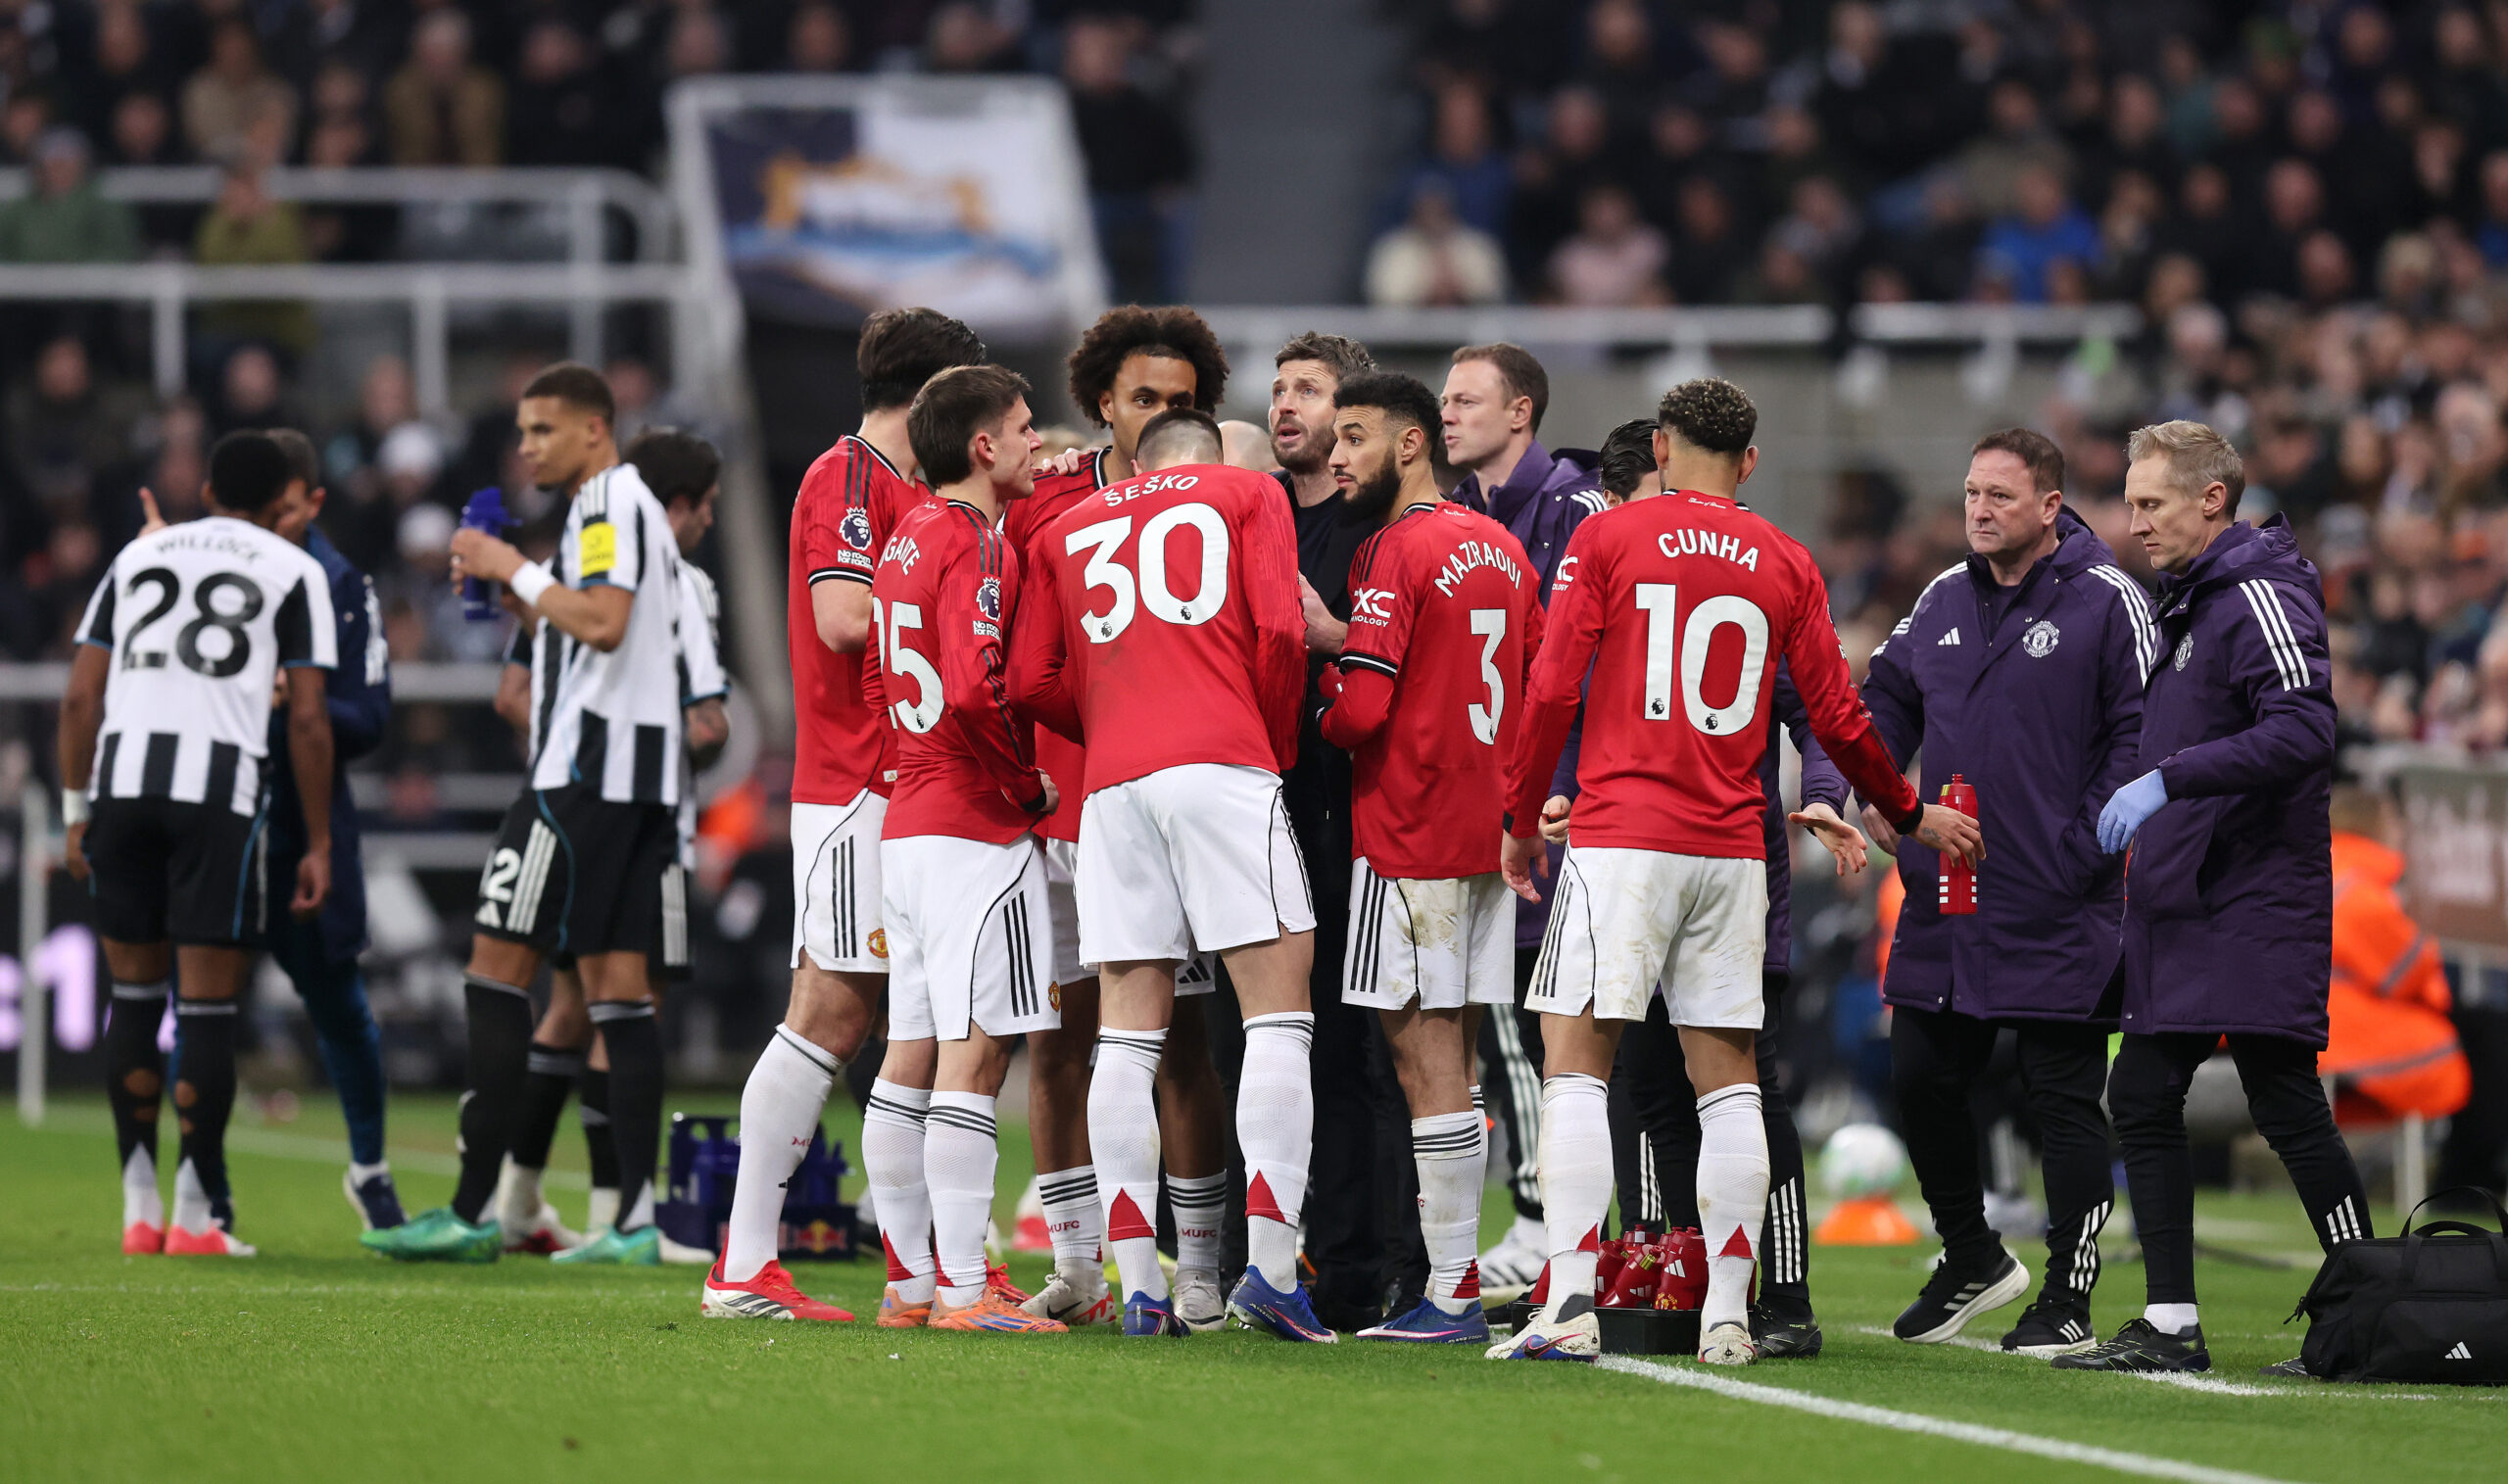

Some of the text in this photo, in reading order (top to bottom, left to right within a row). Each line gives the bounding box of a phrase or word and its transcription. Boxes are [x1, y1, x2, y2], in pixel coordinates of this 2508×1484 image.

[1103, 474, 1199, 507] ŠEŠKO
[157, 534, 262, 565] WILLOCK
[838, 550, 851, 558] No
[1658, 528, 1760, 573] CUNHA
[1065, 502, 1230, 644] 30
[1433, 540, 1521, 598] MAZRAOUI
[1352, 587, 1396, 619] XC
[121, 565, 265, 678] 28
[973, 620, 986, 630] No
[1468, 608, 1507, 745] 3
[1635, 583, 1769, 737] 10
[1048, 1220, 1081, 1233] MUFC
[1182, 1228, 1217, 1238] MUFC
